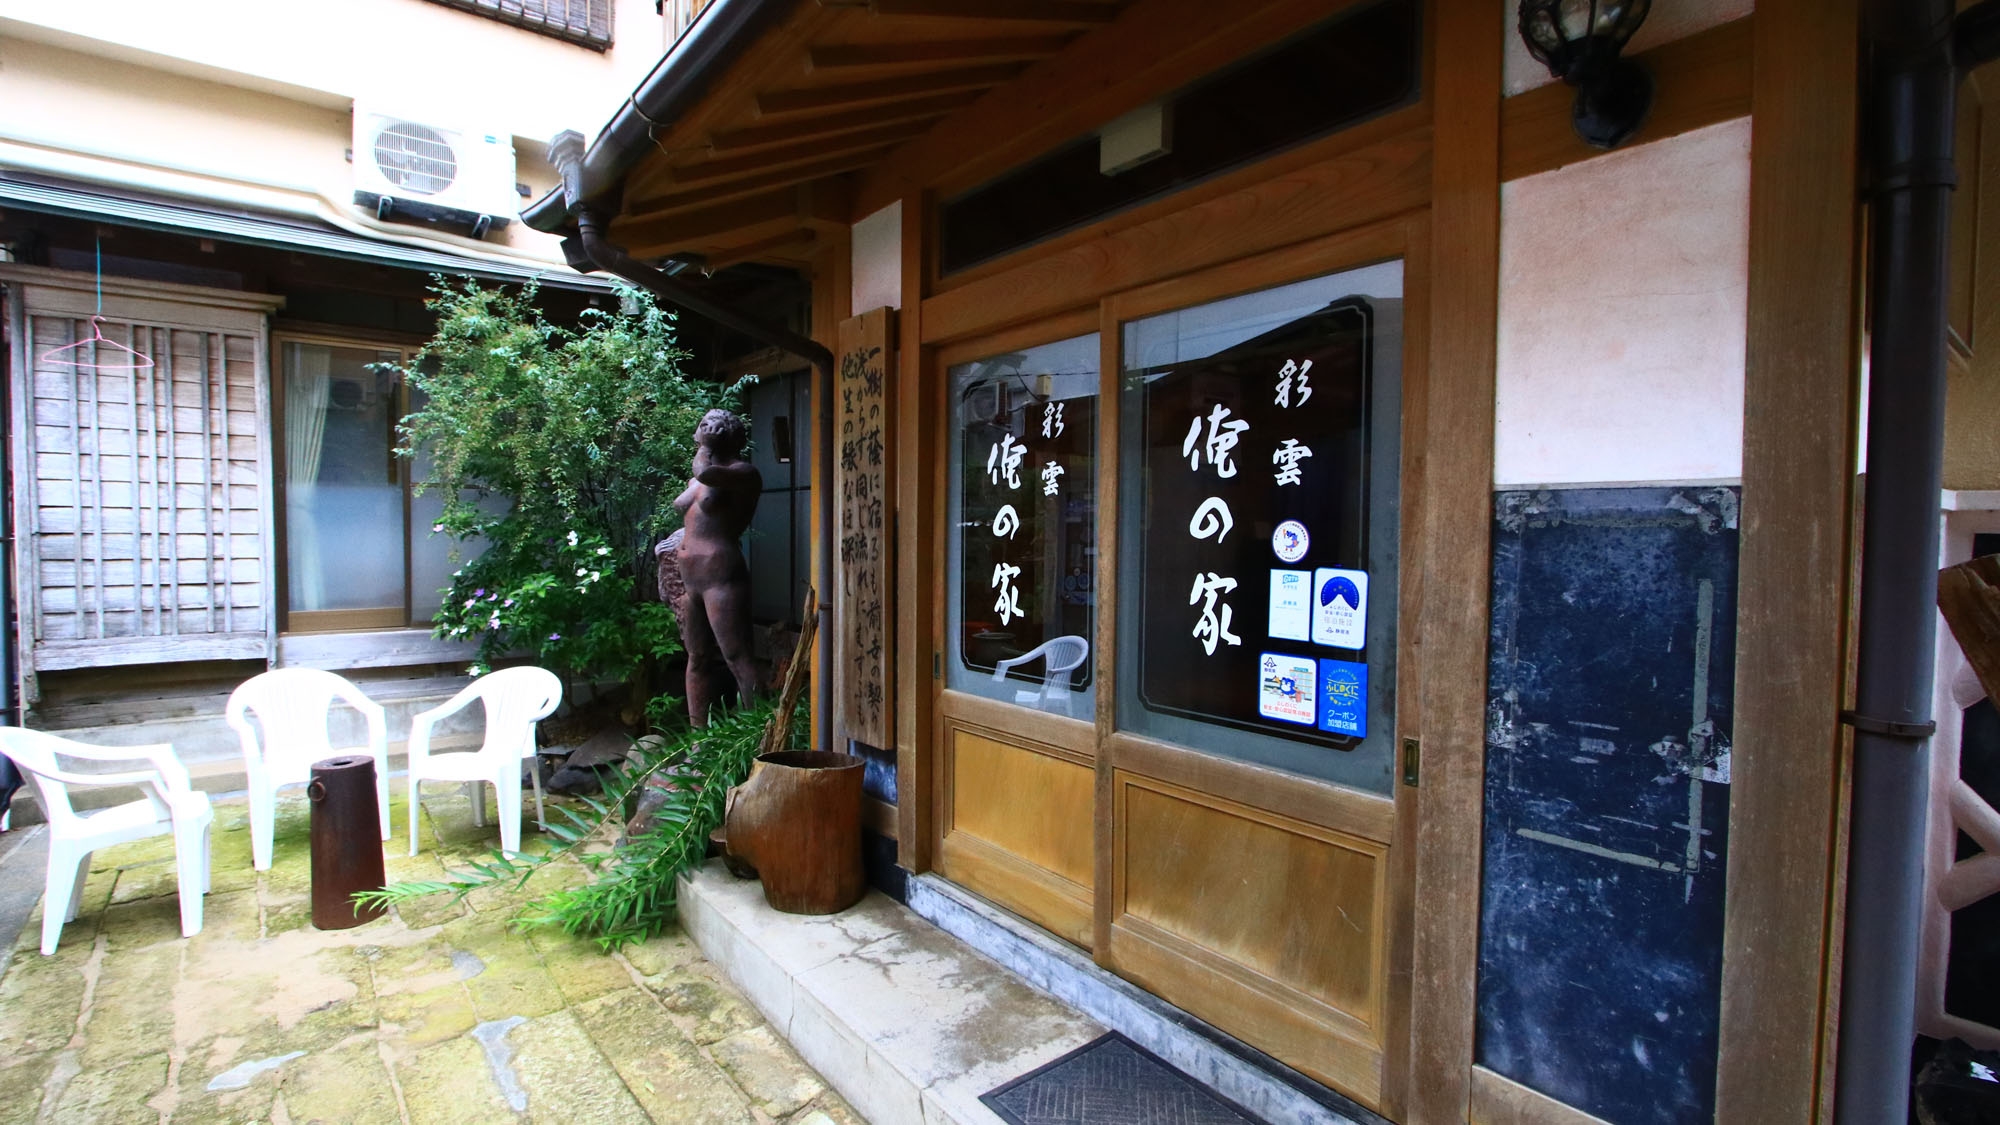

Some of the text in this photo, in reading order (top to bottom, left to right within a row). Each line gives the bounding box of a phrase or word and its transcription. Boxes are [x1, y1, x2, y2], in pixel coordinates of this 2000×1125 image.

[1041, 402, 1065, 497] 彩雲
[1273, 359, 1312, 486] 彩雲
[987, 433, 1028, 626] 俺の家
[1183, 403, 1250, 656] 俺の家
[1327, 709, 1357, 721] クーポン
